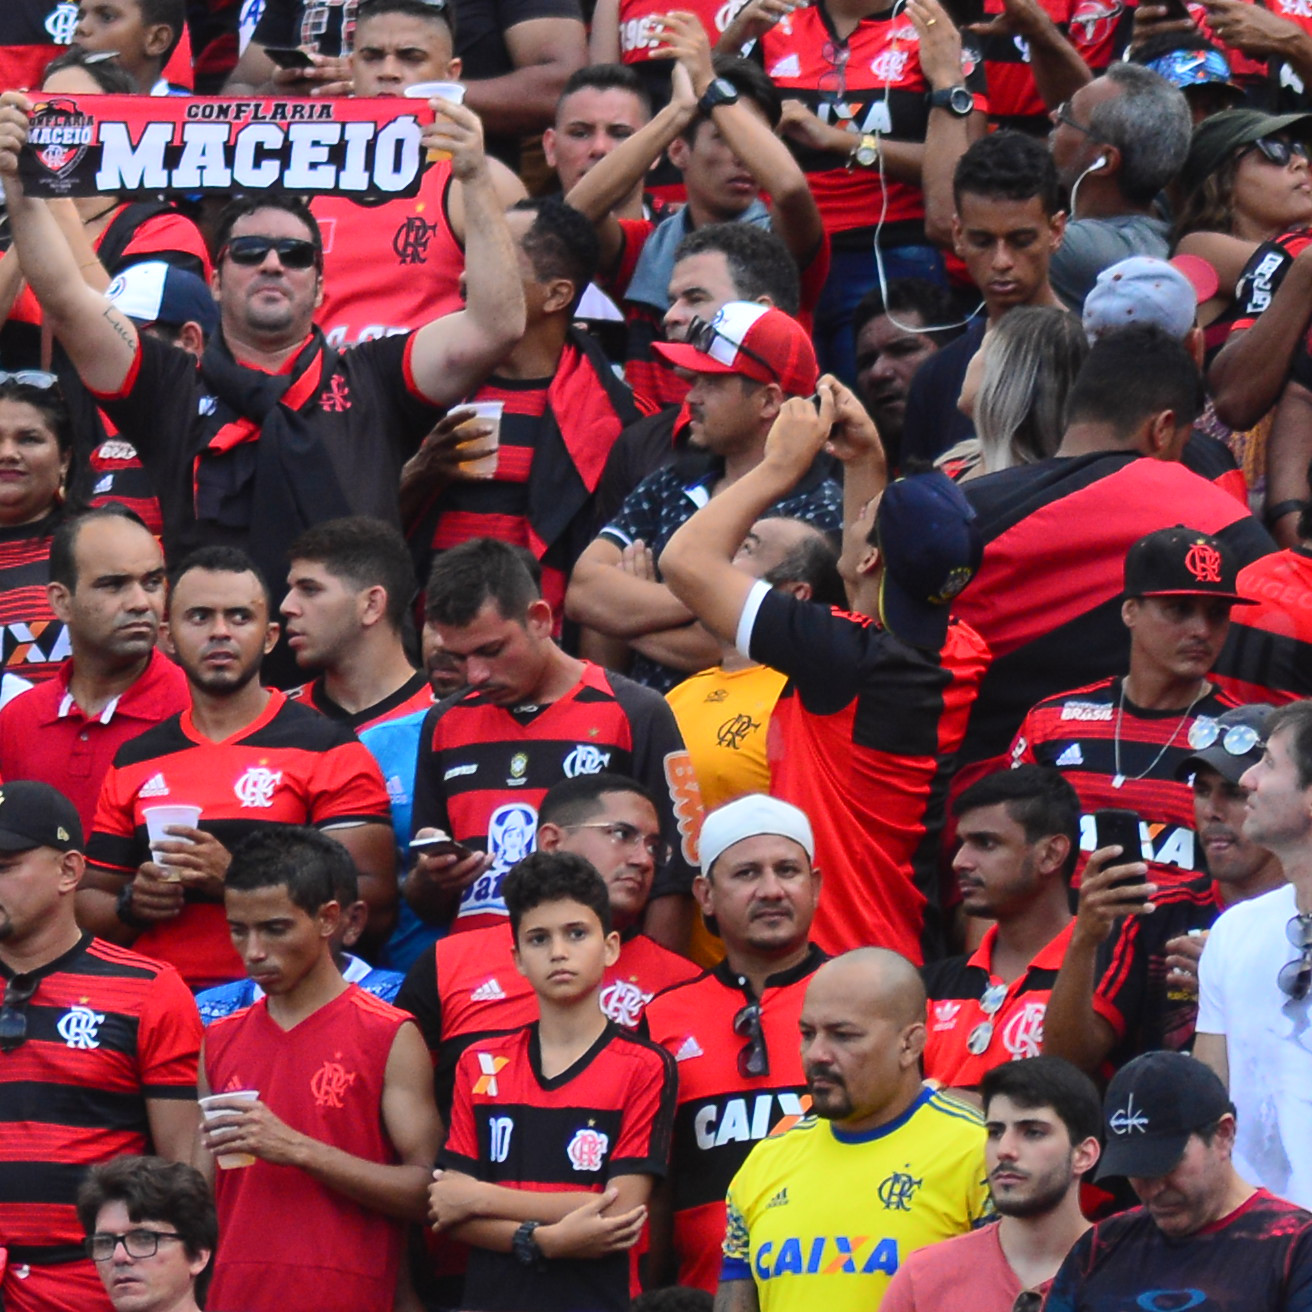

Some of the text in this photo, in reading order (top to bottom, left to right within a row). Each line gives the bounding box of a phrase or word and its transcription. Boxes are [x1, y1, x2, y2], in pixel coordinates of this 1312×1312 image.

[28, 115, 94, 128] ONFLARIA
[186, 102, 334, 121] CONFLARIA
[95, 115, 423, 192] MACEIÓ
[488, 1117, 512, 1161] 10
[692, 1094, 810, 1150] CAIX
[755, 1236, 899, 1281] CAIXA
